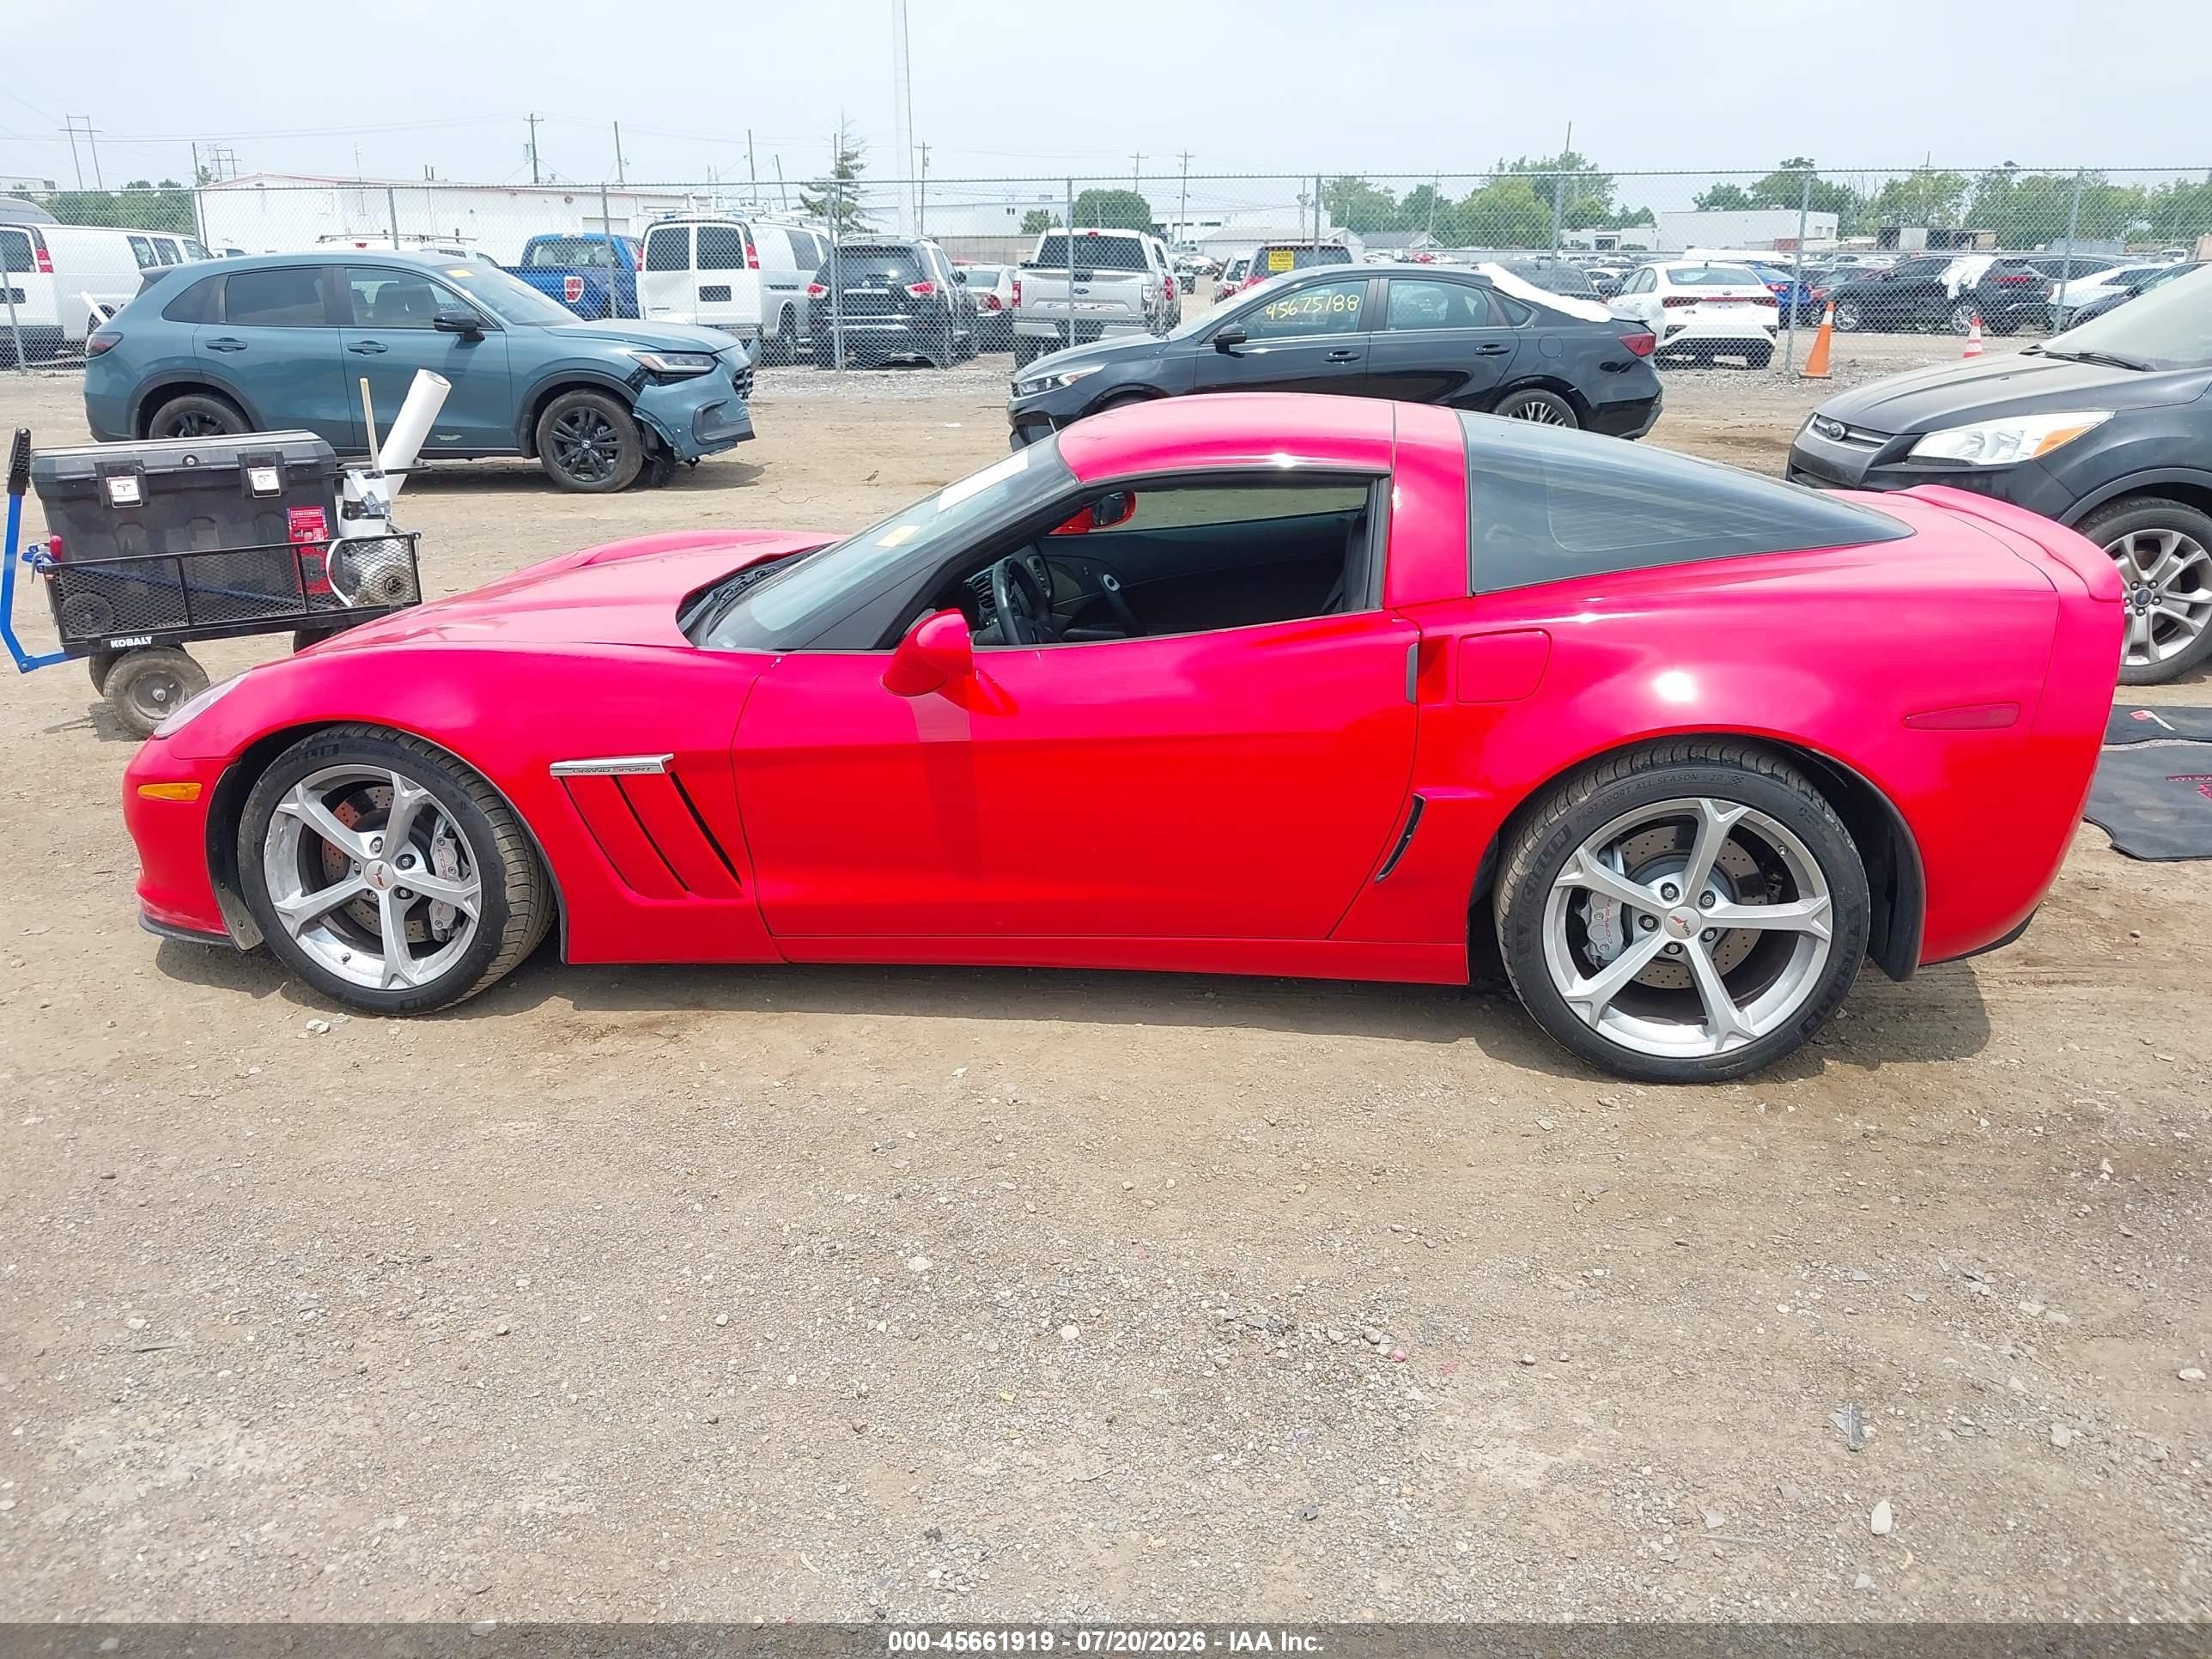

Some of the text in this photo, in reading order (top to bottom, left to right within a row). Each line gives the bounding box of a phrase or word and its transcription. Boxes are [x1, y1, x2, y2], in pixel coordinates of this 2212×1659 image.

[1266, 294, 1360, 320] 45675188
[110, 636, 153, 648] KOBALT
[1602, 786, 1632, 807] SPORT
[1635, 779, 1653, 791] ALL
[1656, 773, 1698, 785] SEASON
